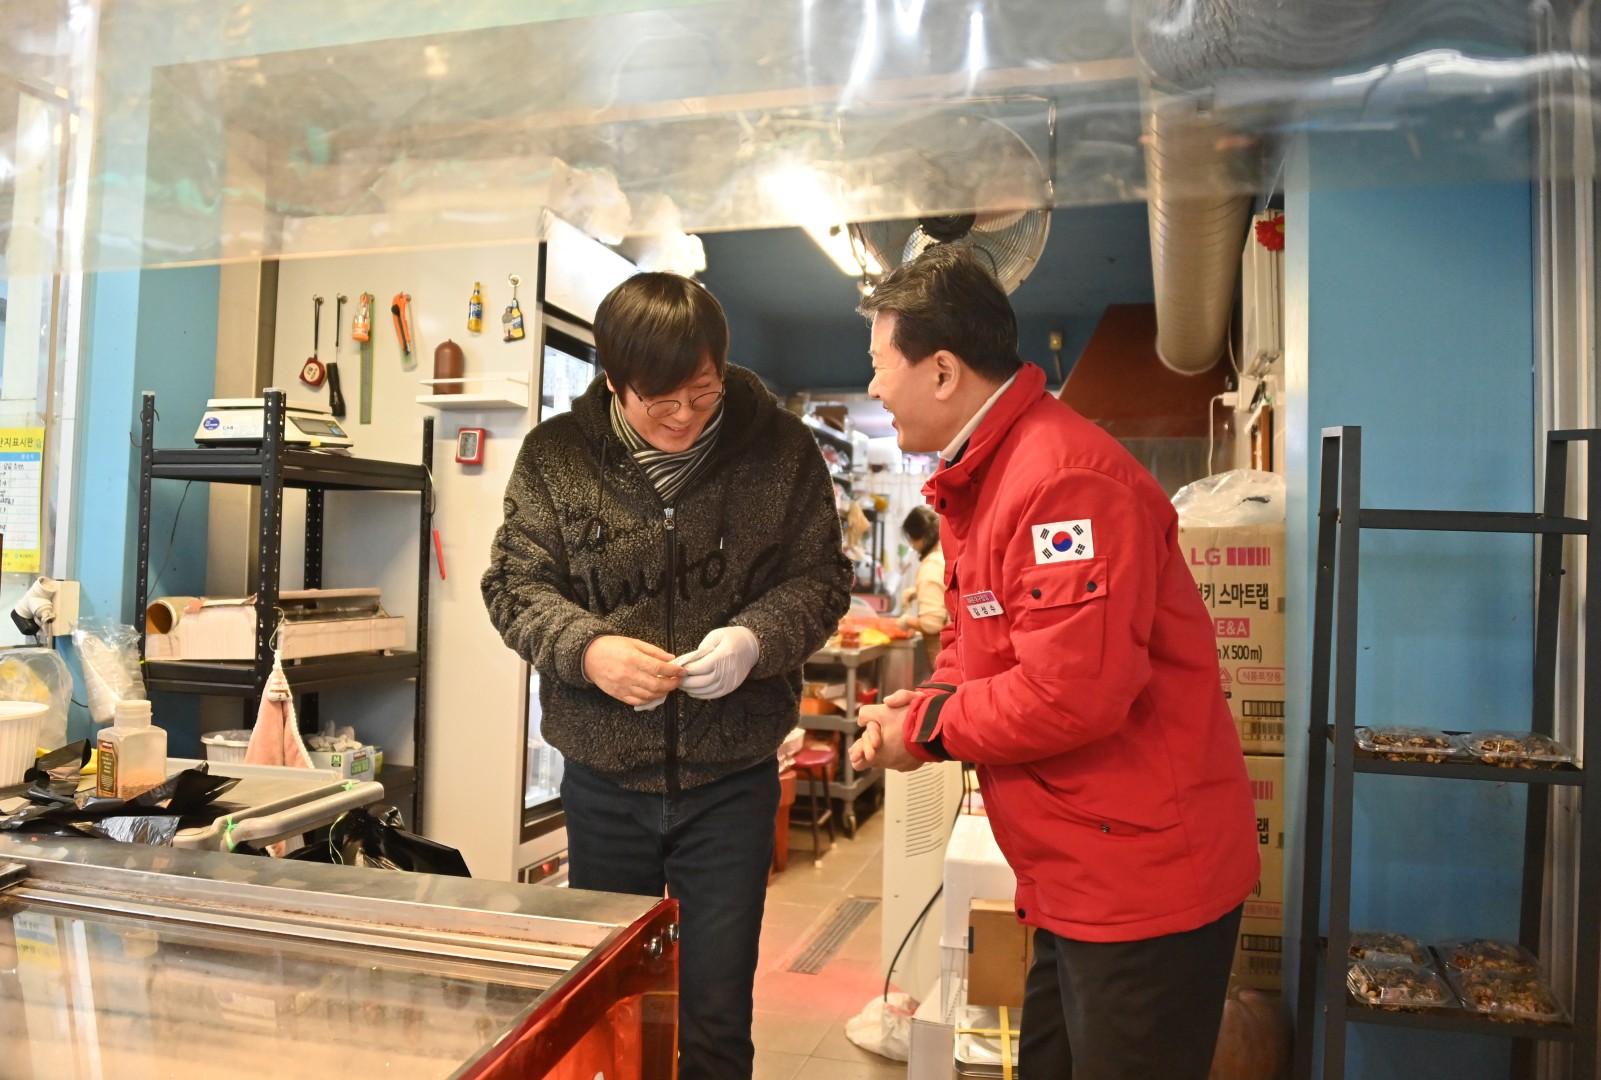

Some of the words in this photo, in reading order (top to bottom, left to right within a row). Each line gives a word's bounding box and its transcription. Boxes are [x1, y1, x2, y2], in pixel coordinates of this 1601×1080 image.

[1191, 547, 1221, 566] LG
[1219, 583, 1269, 610] 스마트랩
[1217, 619, 1247, 635] E&A
